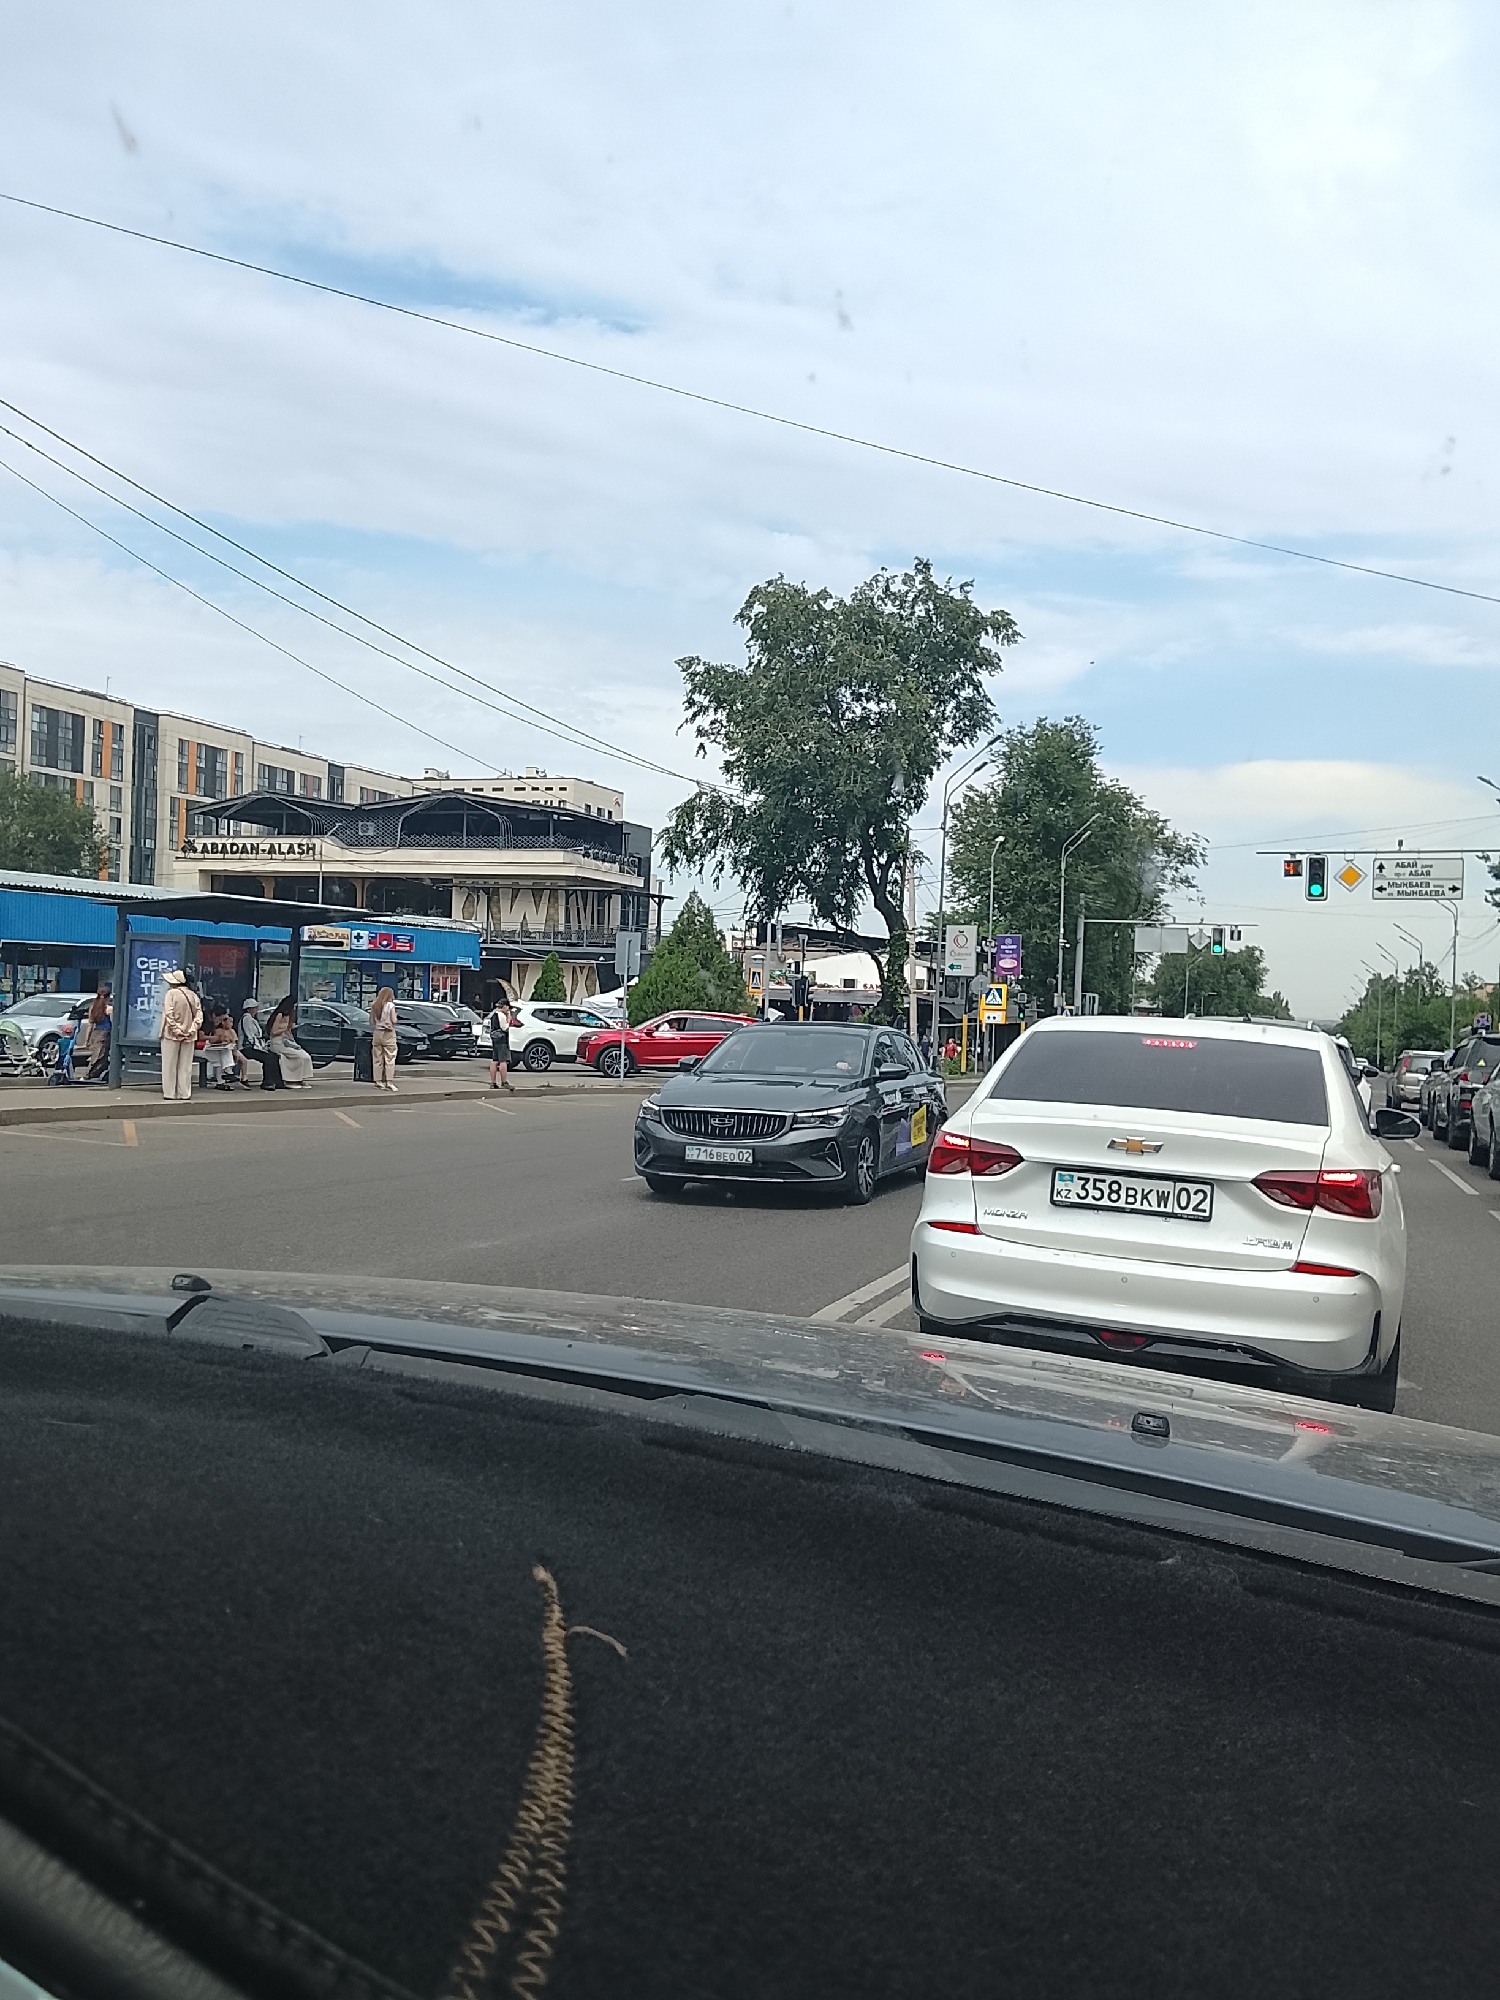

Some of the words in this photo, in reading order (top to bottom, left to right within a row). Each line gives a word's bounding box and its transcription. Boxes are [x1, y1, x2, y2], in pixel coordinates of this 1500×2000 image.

[200, 842, 316, 855] ABADAN-ALASH
[1395, 860, 1418, 869] АБАЙ
[1408, 869, 1431, 877] АБАЯ
[1055, 1188, 1072, 1200] KZ
[1176, 1187, 1208, 1213] 02
[983, 1208, 1029, 1220] MONZA
